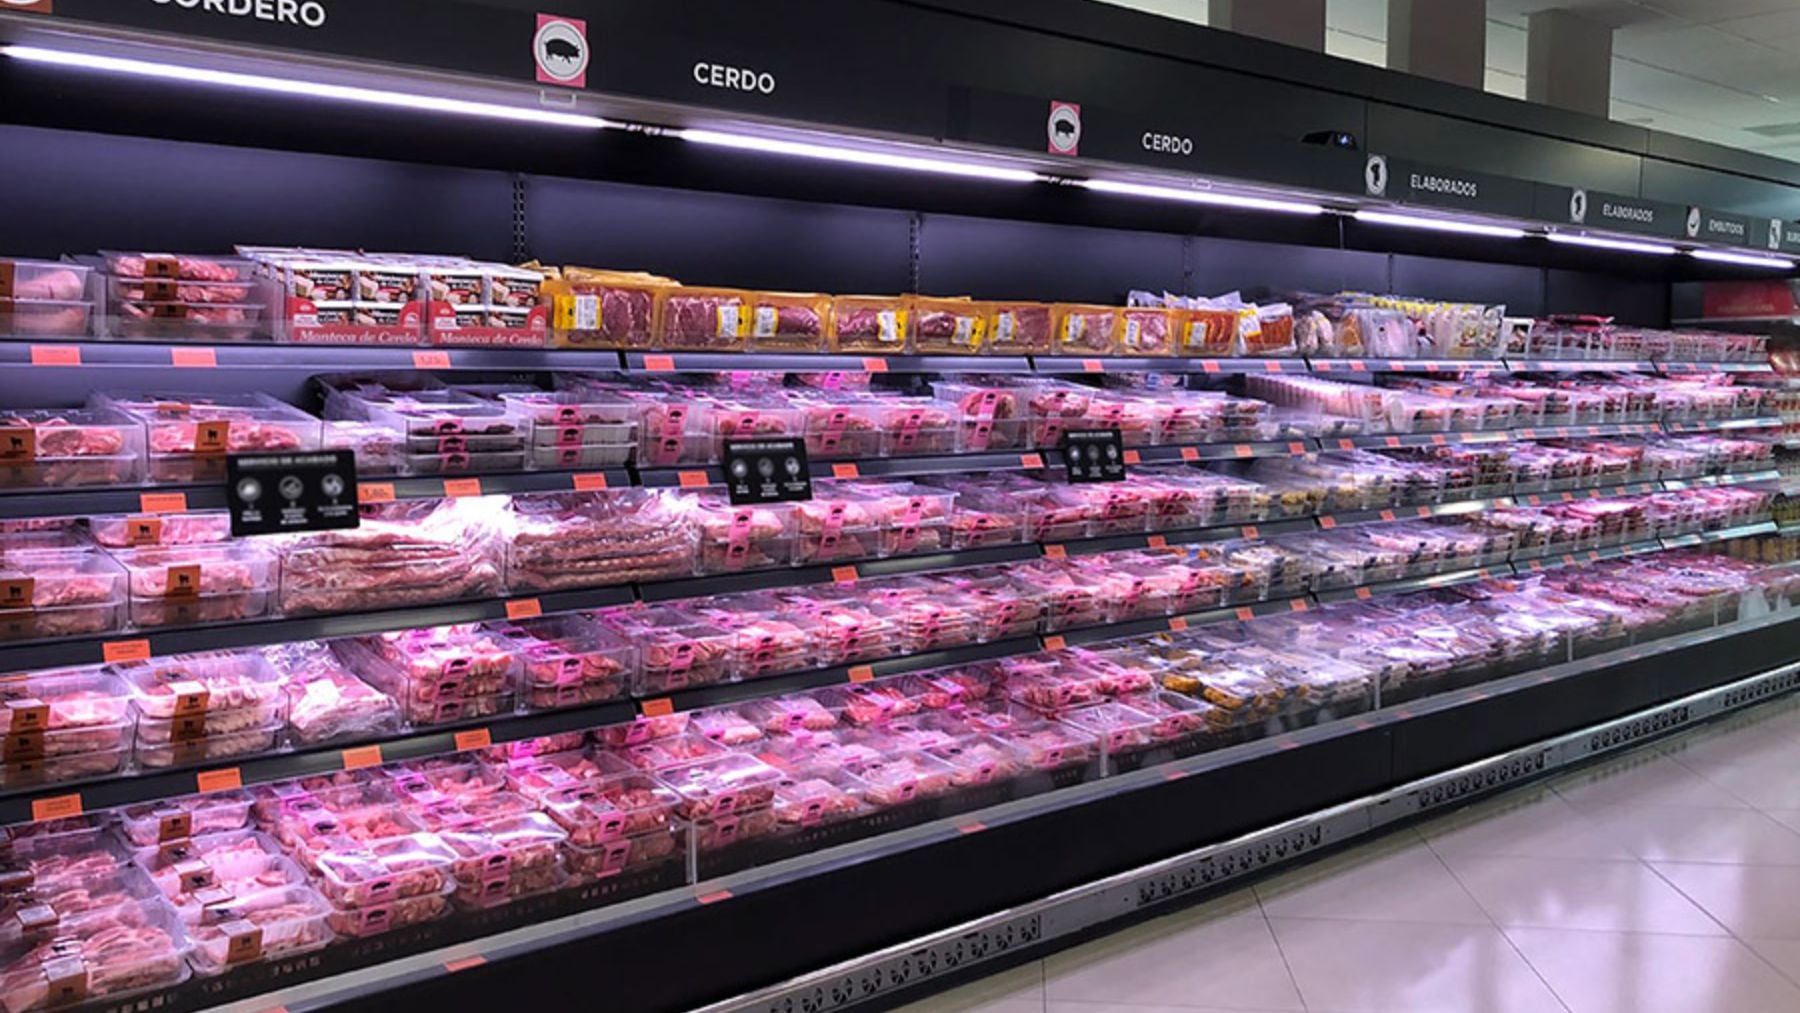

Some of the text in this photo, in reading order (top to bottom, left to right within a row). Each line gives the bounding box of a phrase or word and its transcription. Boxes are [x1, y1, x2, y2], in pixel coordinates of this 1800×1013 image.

[153, 0, 326, 27] RDERO
[693, 62, 775, 94] CERDO
[1142, 132, 1193, 155] CERDO
[1410, 174, 1477, 197] ELABORADOS
[1603, 204, 1653, 222] ELABORADOS
